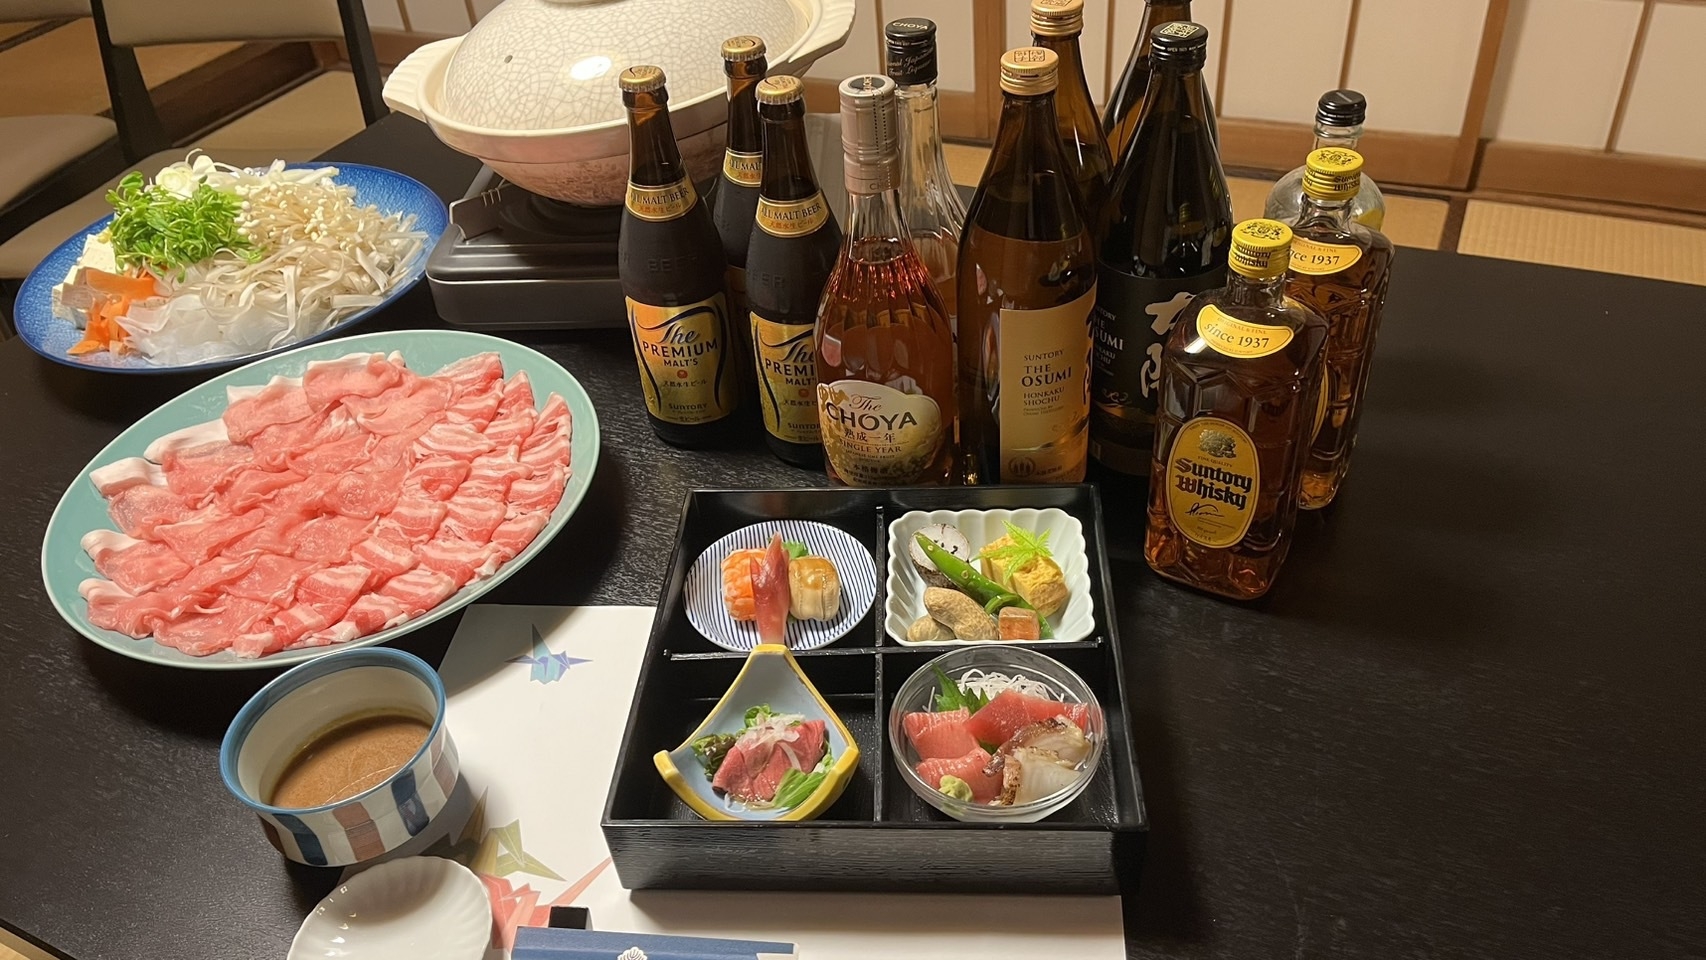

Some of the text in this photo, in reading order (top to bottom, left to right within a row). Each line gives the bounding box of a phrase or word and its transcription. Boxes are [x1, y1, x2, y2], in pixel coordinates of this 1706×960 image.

[892, 21, 928, 30] CHOYA
[669, 187, 689, 202] BEER
[774, 210, 800, 221] MALT
[801, 202, 822, 218] BEER
[1311, 254, 1340, 266] 1937
[656, 322, 700, 344] The
[1094, 326, 1124, 351] SUMI
[1204, 323, 1235, 344] since
[1237, 335, 1270, 348] 1937
[642, 337, 718, 358] PREMIUM
[1024, 349, 1064, 361] SUNTORY
[663, 358, 698, 367] MALT'S
[765, 357, 814, 377] PREMI
[1024, 363, 1051, 374] THE
[785, 377, 816, 386] MALT'
[1021, 366, 1072, 387] OSUMI
[1023, 386, 1065, 399] HONKAKU
[1023, 395, 1060, 406] SHOCHU
[849, 393, 882, 411] The
[826, 402, 918, 431] CHOYA
[787, 422, 820, 430] SUNTO
[844, 427, 896, 443] 熟成一年
[840, 438, 902, 453] SINGLE YEAR
[1174, 457, 1253, 493] Suntory
[1174, 474, 1247, 511] Whisky
